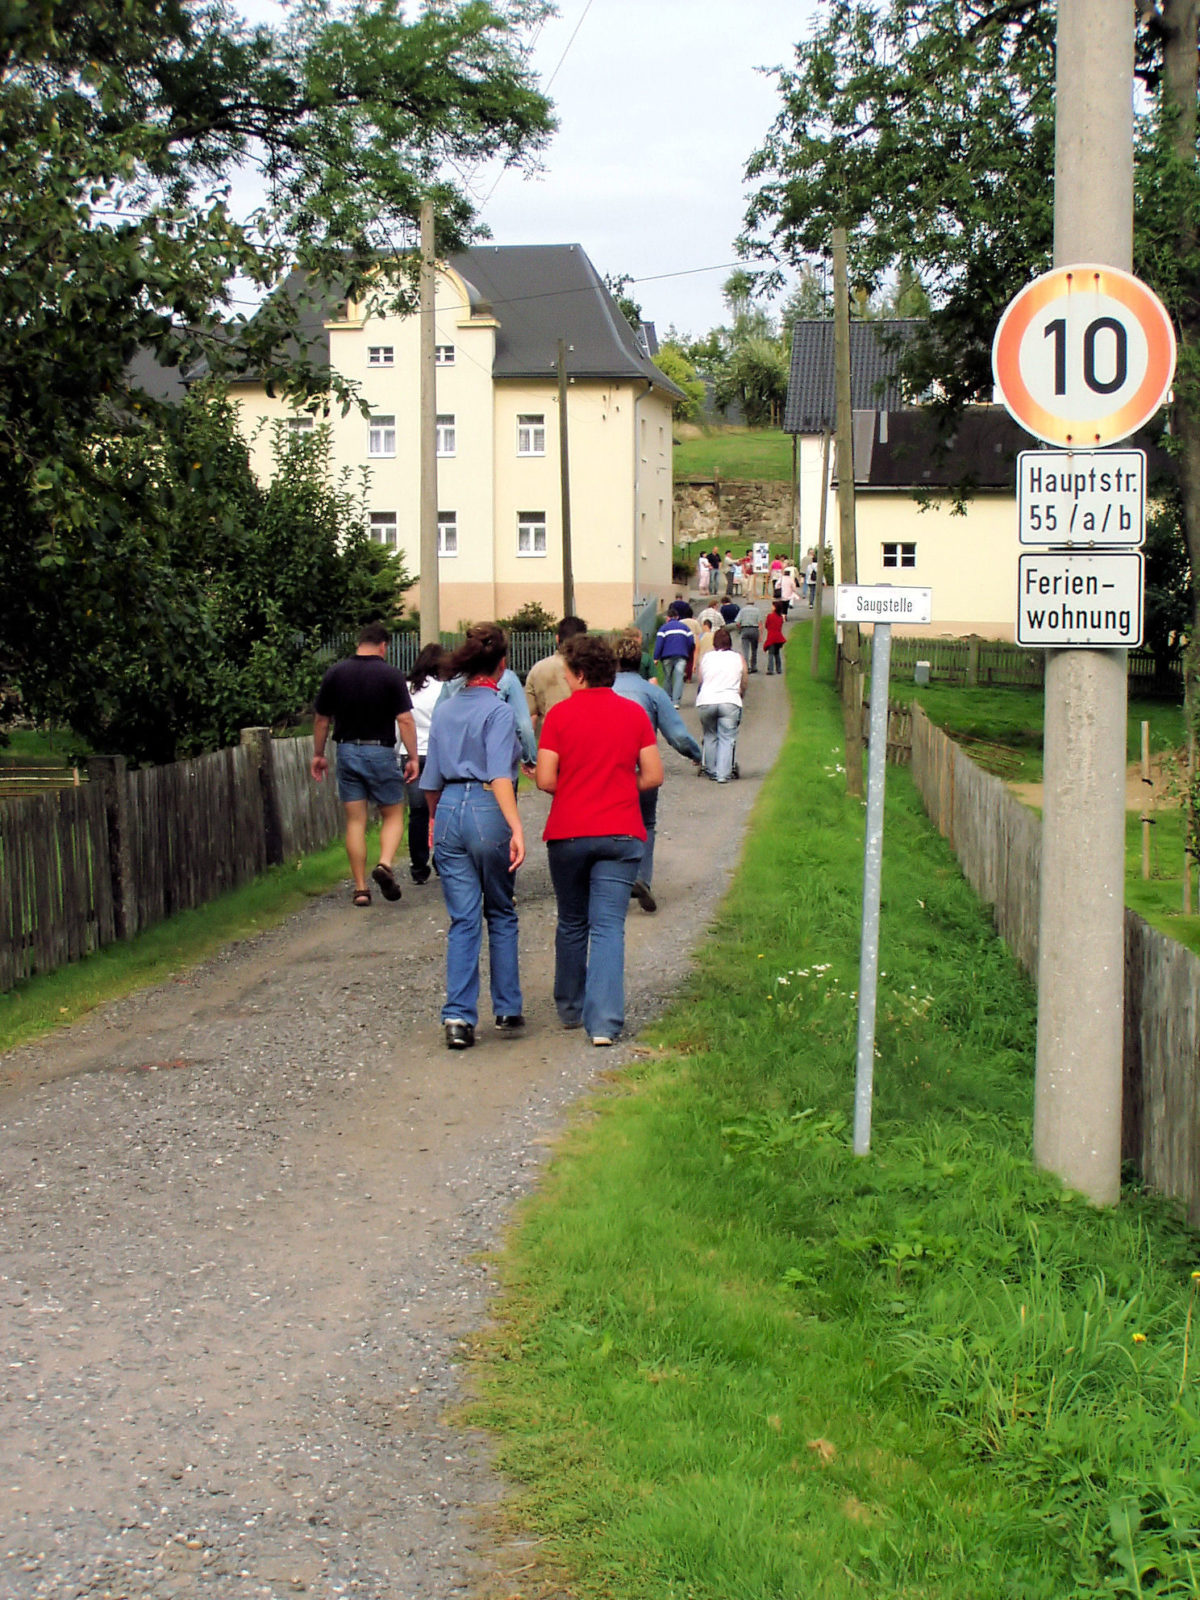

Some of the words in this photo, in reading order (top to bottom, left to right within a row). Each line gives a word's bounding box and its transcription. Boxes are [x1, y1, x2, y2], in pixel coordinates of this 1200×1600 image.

[1044, 316, 1127, 395] 10
[1030, 467, 1137, 500] Hauptstr.
[1026, 568, 1115, 595] Ferien-
[856, 595, 913, 615] Saugstelle
[1027, 603, 1130, 636] wohnung
